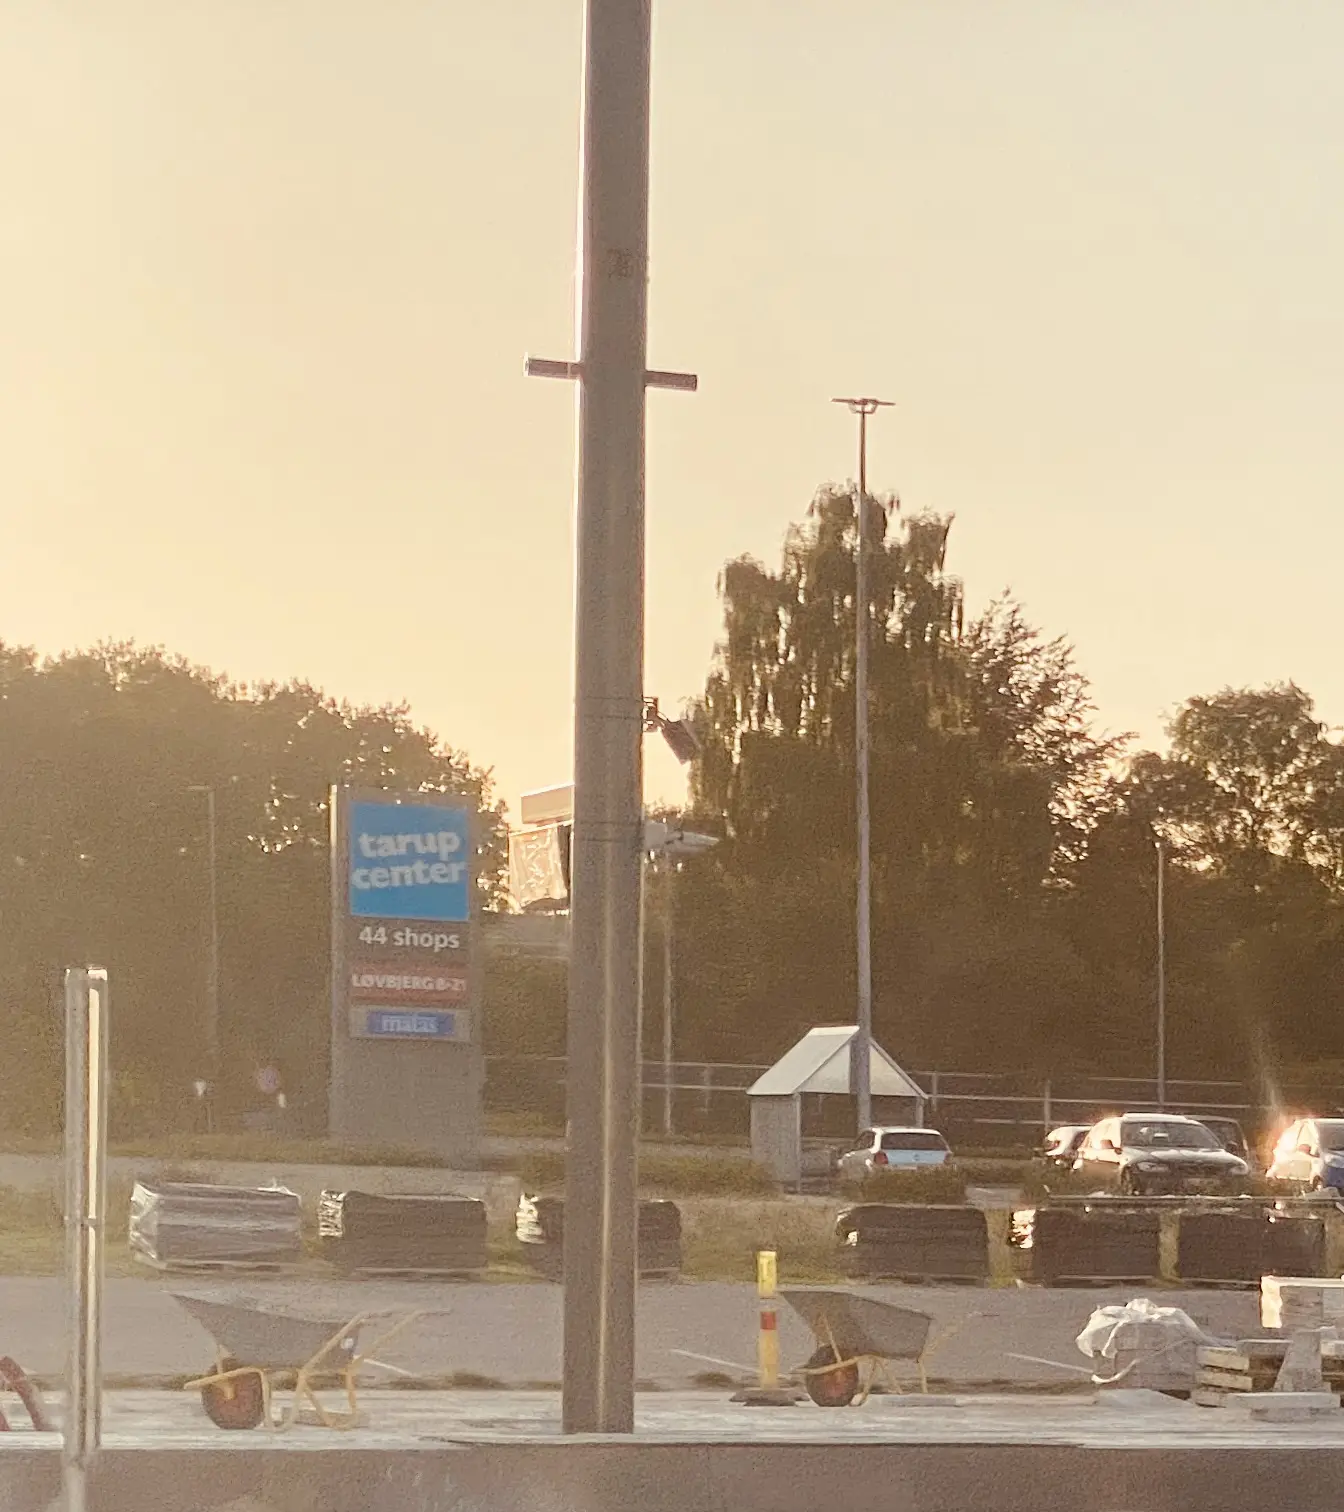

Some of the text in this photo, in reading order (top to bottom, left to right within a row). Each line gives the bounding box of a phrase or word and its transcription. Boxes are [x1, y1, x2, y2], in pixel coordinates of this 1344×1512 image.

[359, 830, 460, 861] tarup
[352, 860, 466, 889] center
[359, 926, 460, 952] 44 shops
[351, 973, 434, 990] LØVBJERG
